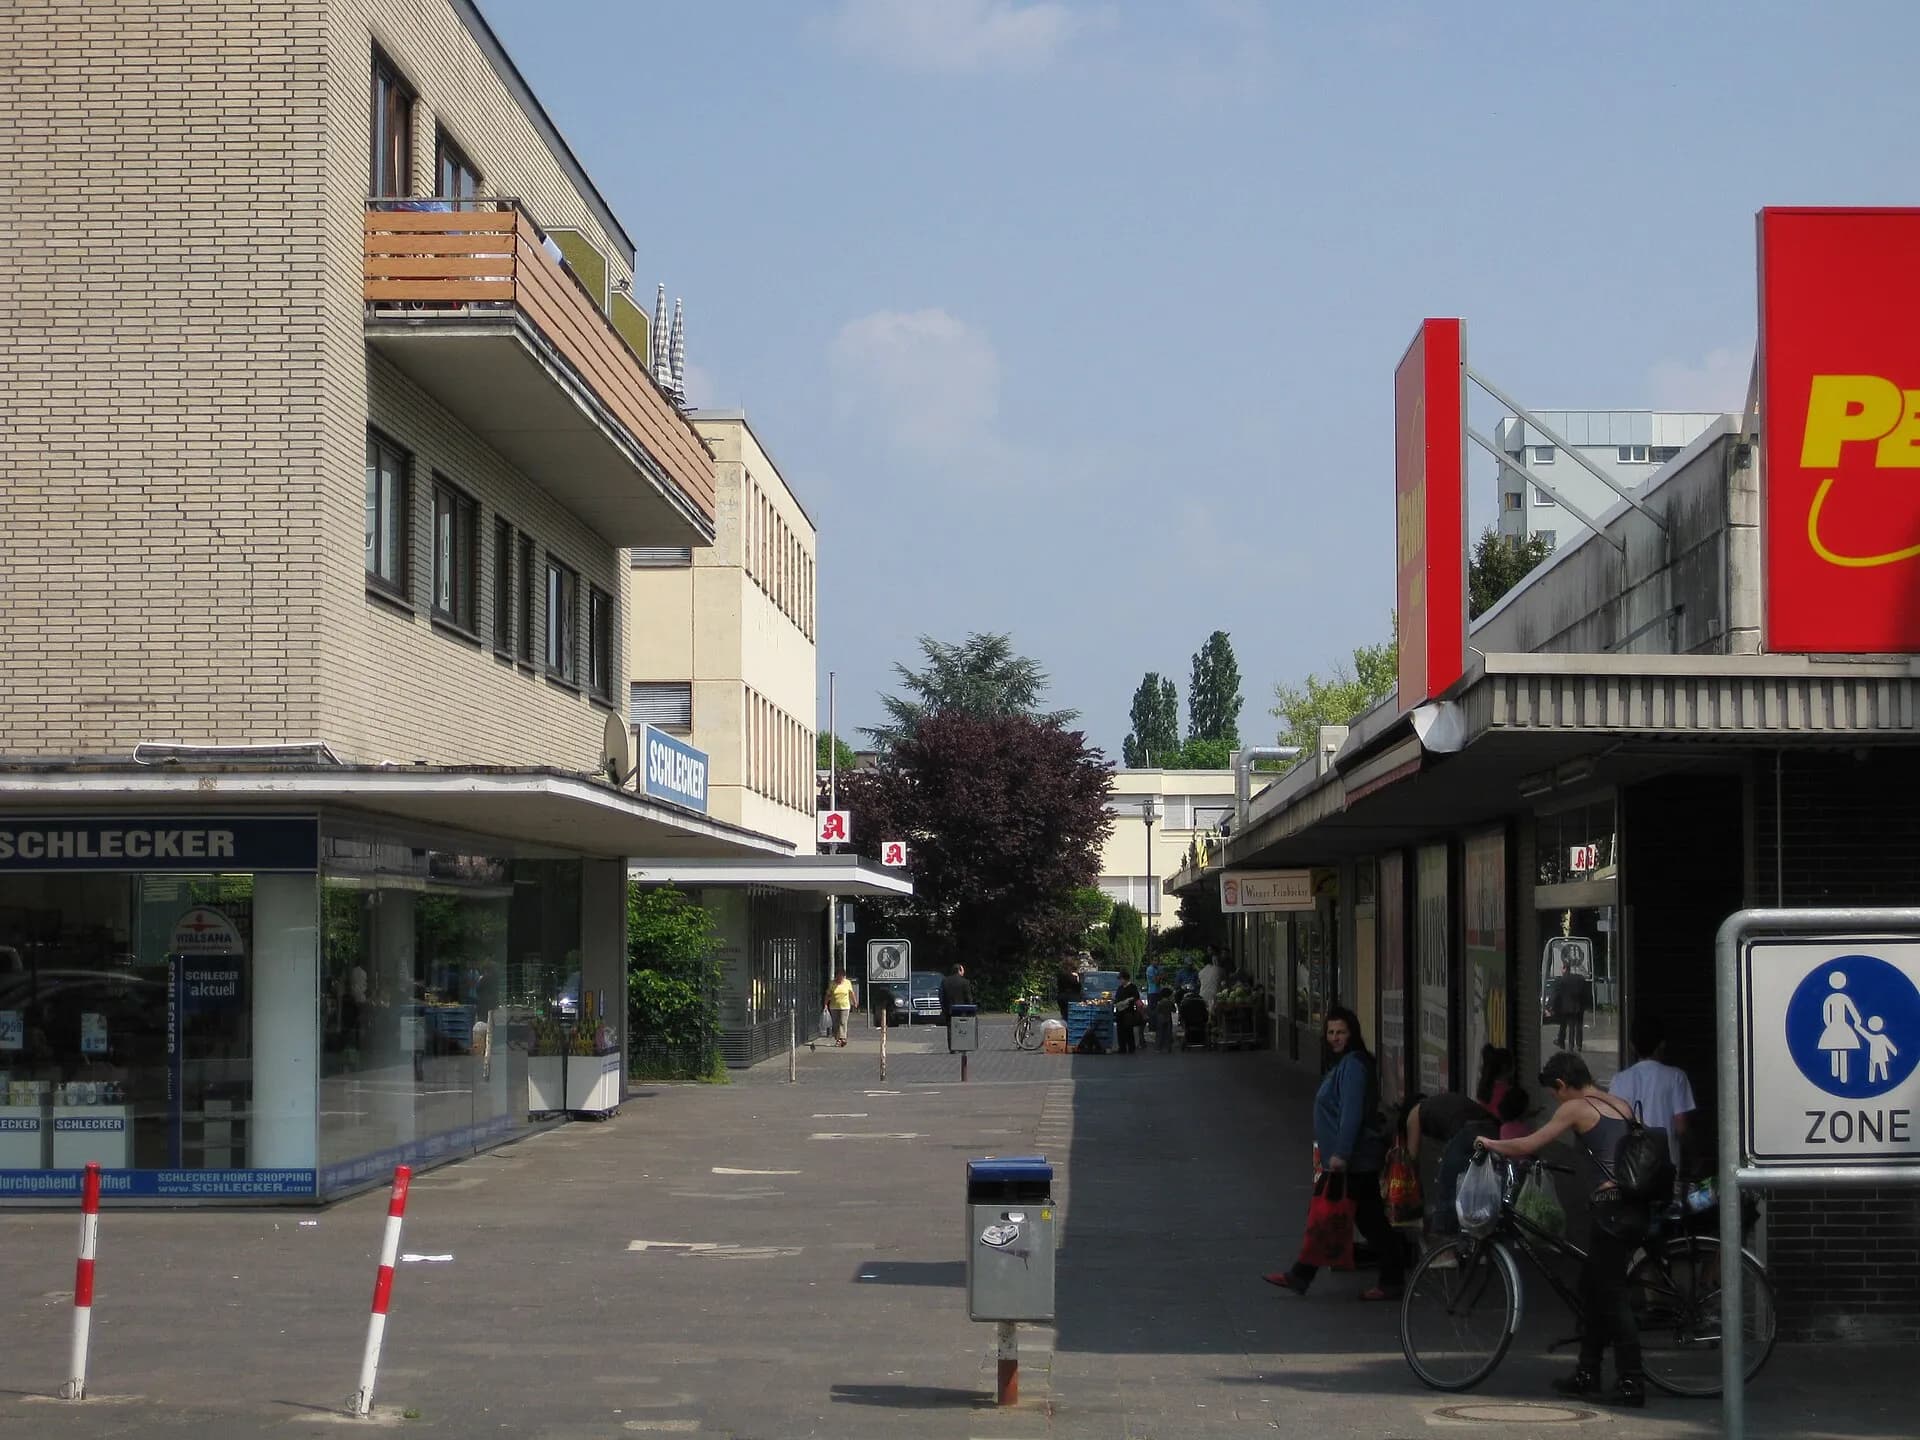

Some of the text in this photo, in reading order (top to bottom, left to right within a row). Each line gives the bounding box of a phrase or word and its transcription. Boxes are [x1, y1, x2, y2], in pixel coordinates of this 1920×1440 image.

[1800, 374, 1920, 468] PE
[650, 739, 704, 801] SCHLECKER
[0, 830, 234, 858] SCHLECKER
[185, 970, 239, 981] SCHLECKER
[191, 981, 235, 996] aktuell
[167, 961, 176, 1054] SCHLECKER
[0, 1119, 37, 1129] ECKER
[56, 1119, 121, 1129] SCHLECKER
[1804, 1109, 1910, 1143] ZONE
[157, 1172, 312, 1182] SCHLECKER HOME SHOPPING
[157, 1183, 312, 1193] www.SCHLECKER.com
